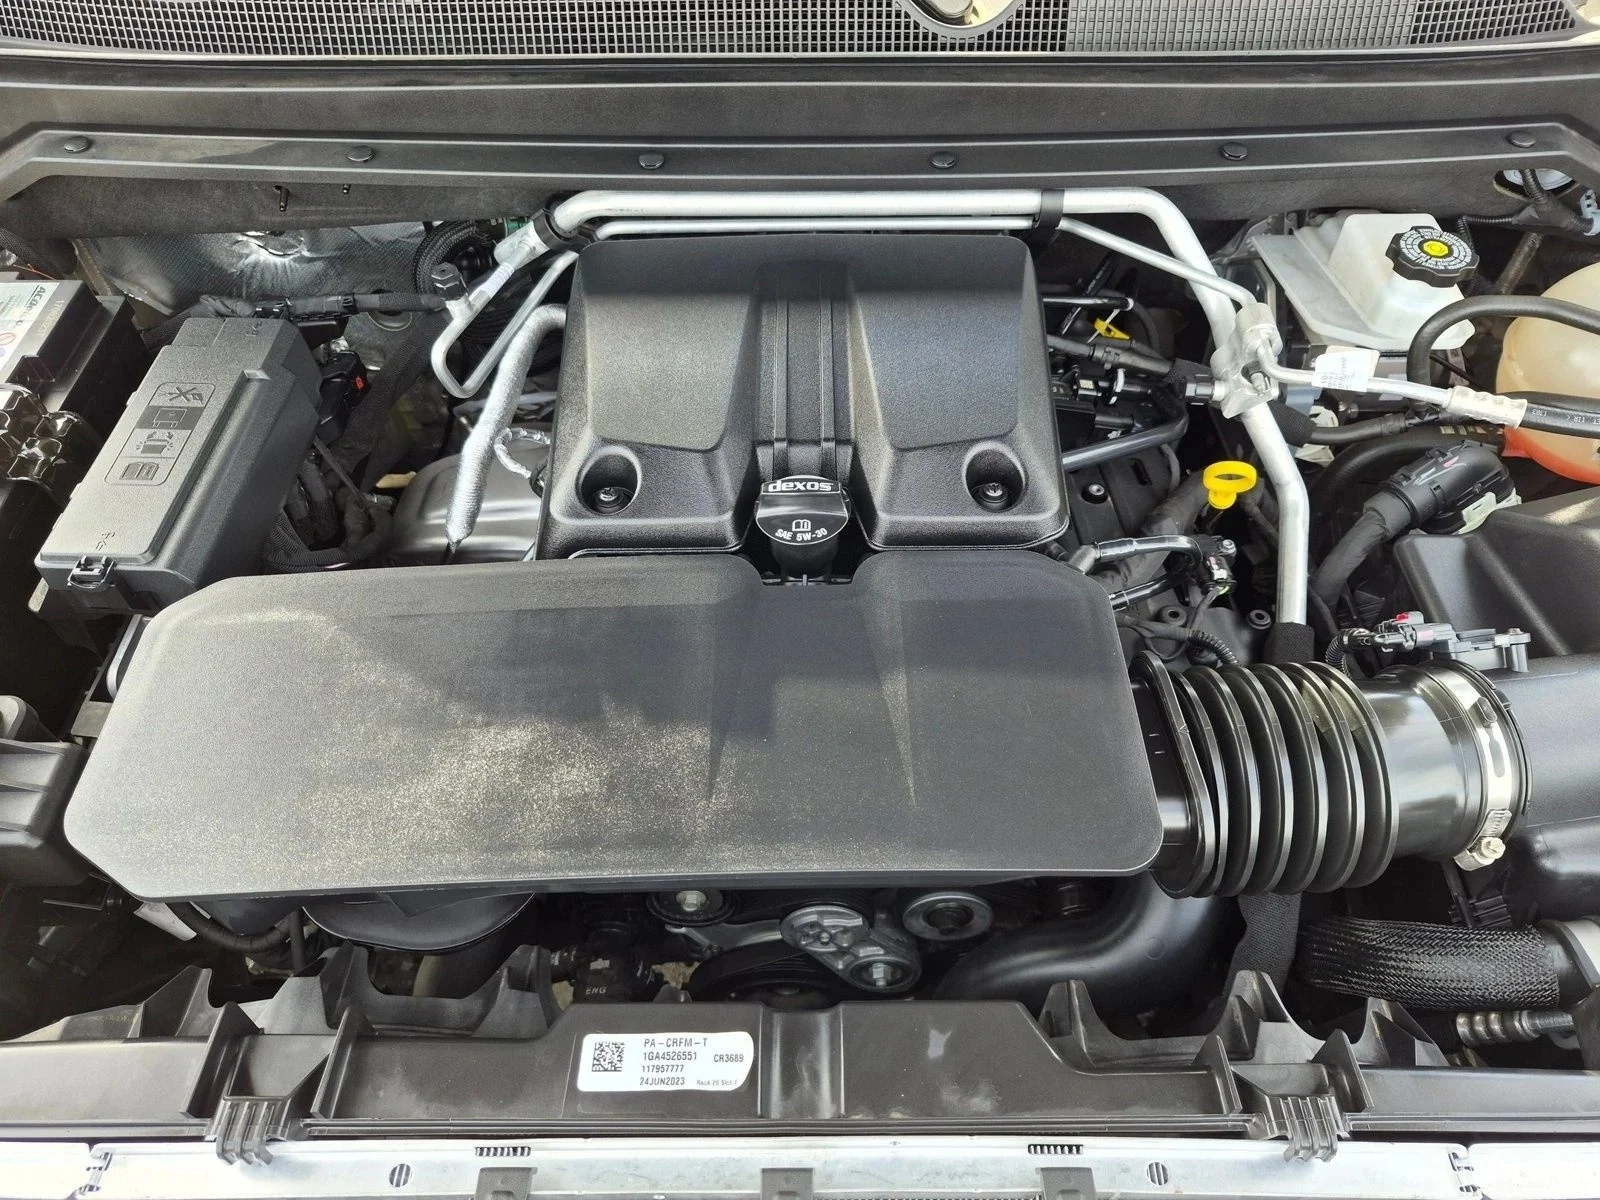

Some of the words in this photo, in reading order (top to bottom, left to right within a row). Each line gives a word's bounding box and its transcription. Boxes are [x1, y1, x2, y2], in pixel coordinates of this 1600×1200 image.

[768, 480, 833, 492] dexos
[775, 528, 793, 540] SAE
[796, 528, 828, 541] 5W-30
[643, 1051, 697, 1061] 1GA4526551
[713, 1053, 744, 1063] CR3689
[641, 1064, 684, 1074] 117957777
[639, 1076, 686, 1086] 24JUN2023
